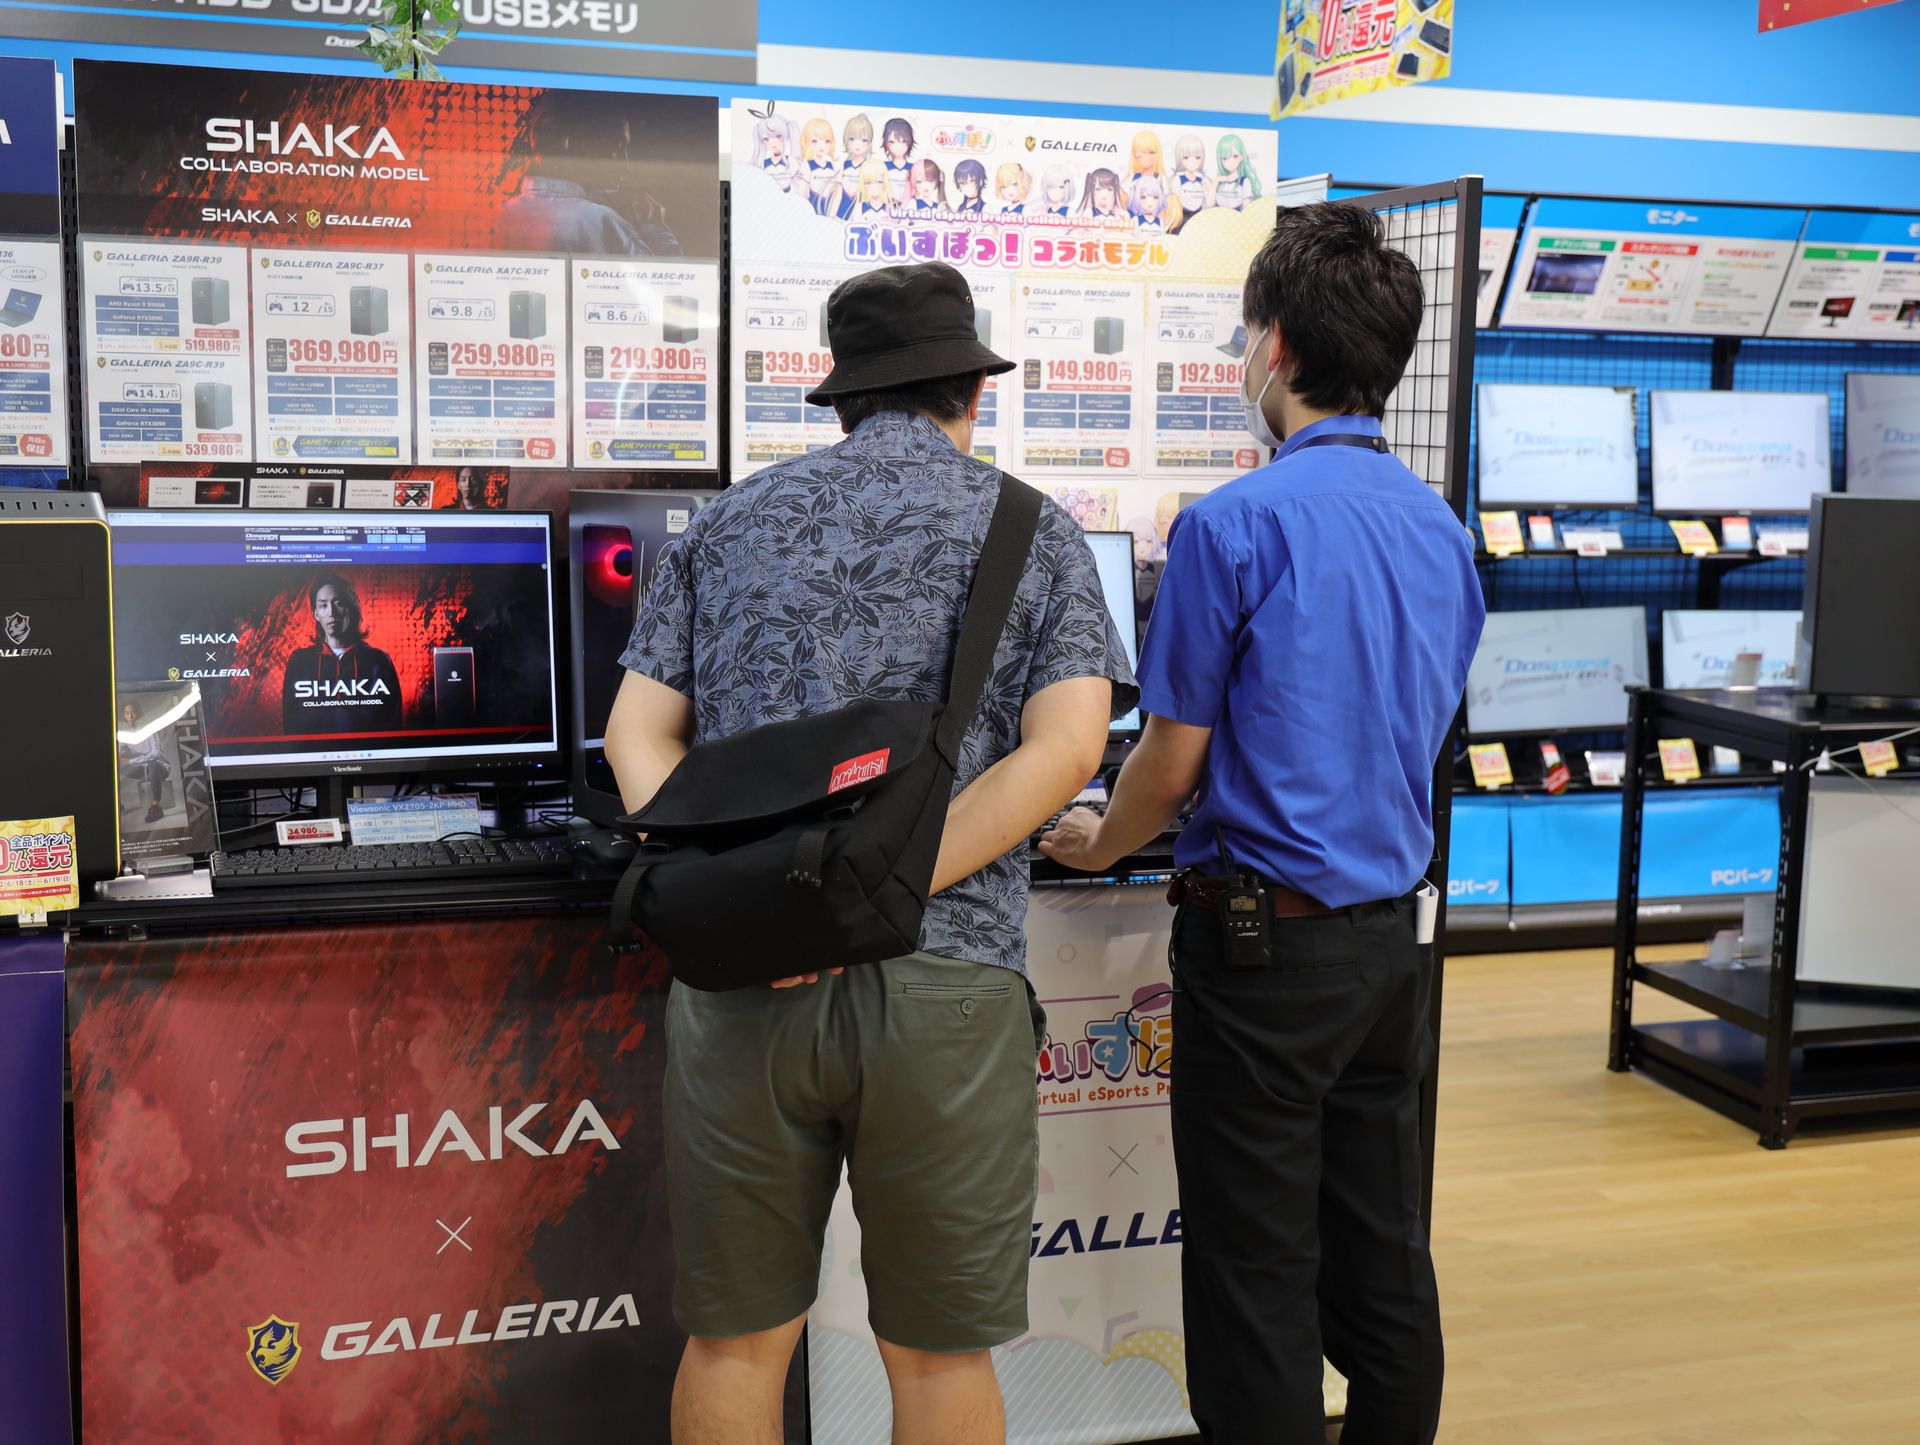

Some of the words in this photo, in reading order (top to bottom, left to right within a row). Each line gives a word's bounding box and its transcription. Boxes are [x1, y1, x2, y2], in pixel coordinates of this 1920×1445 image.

[206, 117, 405, 161] SHAKA
[1041, 139, 1118, 153] GALLERIA
[180, 156, 355, 178] COLLABORATION
[361, 166, 430, 182] MODEL
[201, 208, 280, 225] SHAKA
[325, 214, 412, 229] GALLERIA
[1646, 208, 1699, 225] モニター
[106, 252, 169, 263] GALLERIA
[172, 255, 222, 264] ZA9R-R39
[1033, 239, 1170, 267] コラボモデル
[273, 260, 333, 269] GALLERIA
[336, 262, 384, 270] ZA9C-R37
[436, 265, 493, 274] GALLERIA
[496, 267, 550, 276] XA7C-R36T
[592, 270, 648, 279] GALLERIA
[753, 277, 806, 286] GALLERIA
[1032, 287, 1082, 297] GALLERIA
[1164, 291, 1205, 299] GALLERIA
[292, 302, 310, 312] 12
[450, 306, 473, 317] 9.8
[606, 310, 628, 321] 8.6
[769, 316, 784, 326] 12
[1049, 326, 1057, 336] 7
[1177, 328, 1196, 340] 9.6
[110, 359, 173, 368] GALLERIA
[175, 360, 225, 369] ZA9C-R39
[256, 467, 289, 475] SHAKA
[307, 468, 345, 476] GALLERIA
[179, 633, 240, 645] SHAKA
[183, 668, 251, 679] GALLERIA
[294, 678, 391, 698] SHAKA
[303, 699, 360, 707] COLLABORATION
[360, 698, 384, 706] MODEL
[333, 765, 363, 773] ViewSonic
[350, 804, 391, 814] Viewsonic
[11, 833, 71, 848] 全品ポイント
[1711, 868, 1774, 886] PCパーツ
[1036, 1087, 1082, 1106] irtual
[1088, 1081, 1150, 1102] eSports
[284, 1098, 622, 1179] SHAKA
[320, 1293, 641, 1361] GALLERIA
